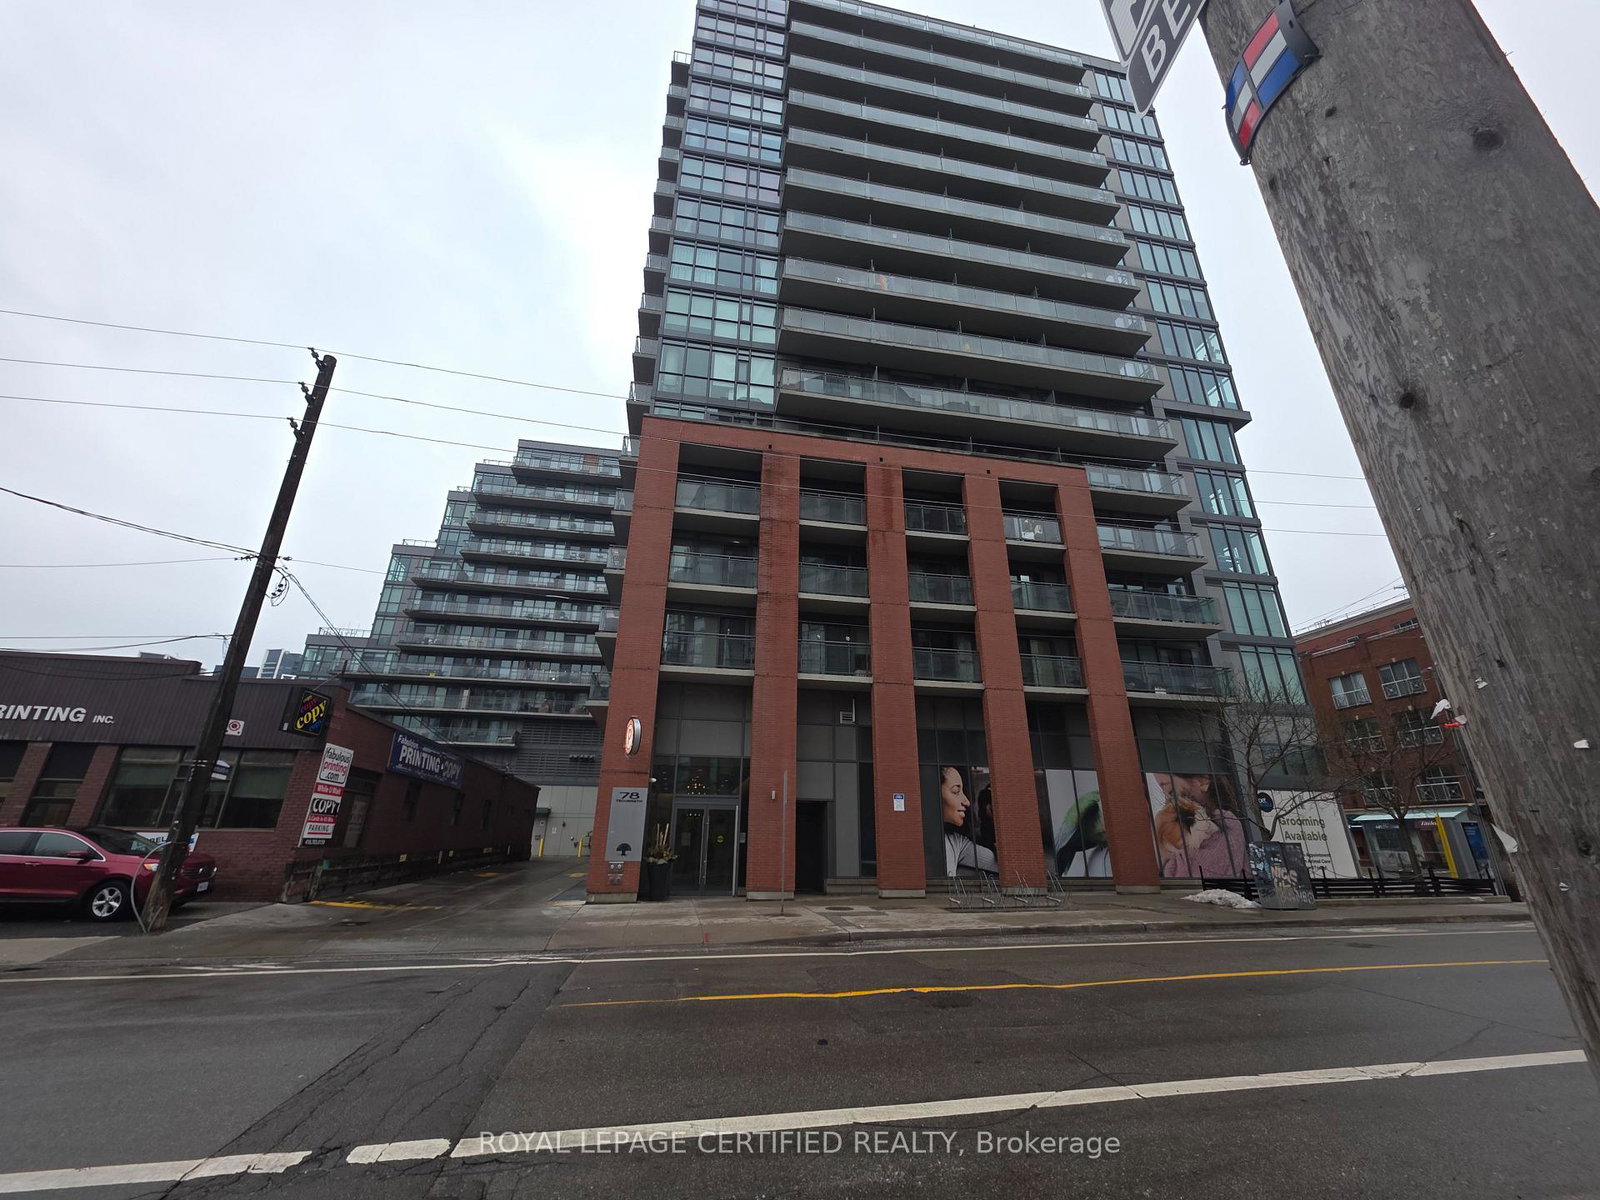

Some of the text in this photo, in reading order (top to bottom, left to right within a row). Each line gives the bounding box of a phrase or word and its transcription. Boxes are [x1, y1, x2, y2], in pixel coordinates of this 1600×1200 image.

[296, 700, 327, 729] copy
[326, 747, 351, 763] fabulous
[399, 745, 441, 773] PRINTING
[324, 761, 348, 777] printing
[619, 791, 640, 800] 78
[308, 824, 330, 832] PARKING
[1280, 816, 1326, 829] Grooming
[1284, 831, 1328, 842] Available
